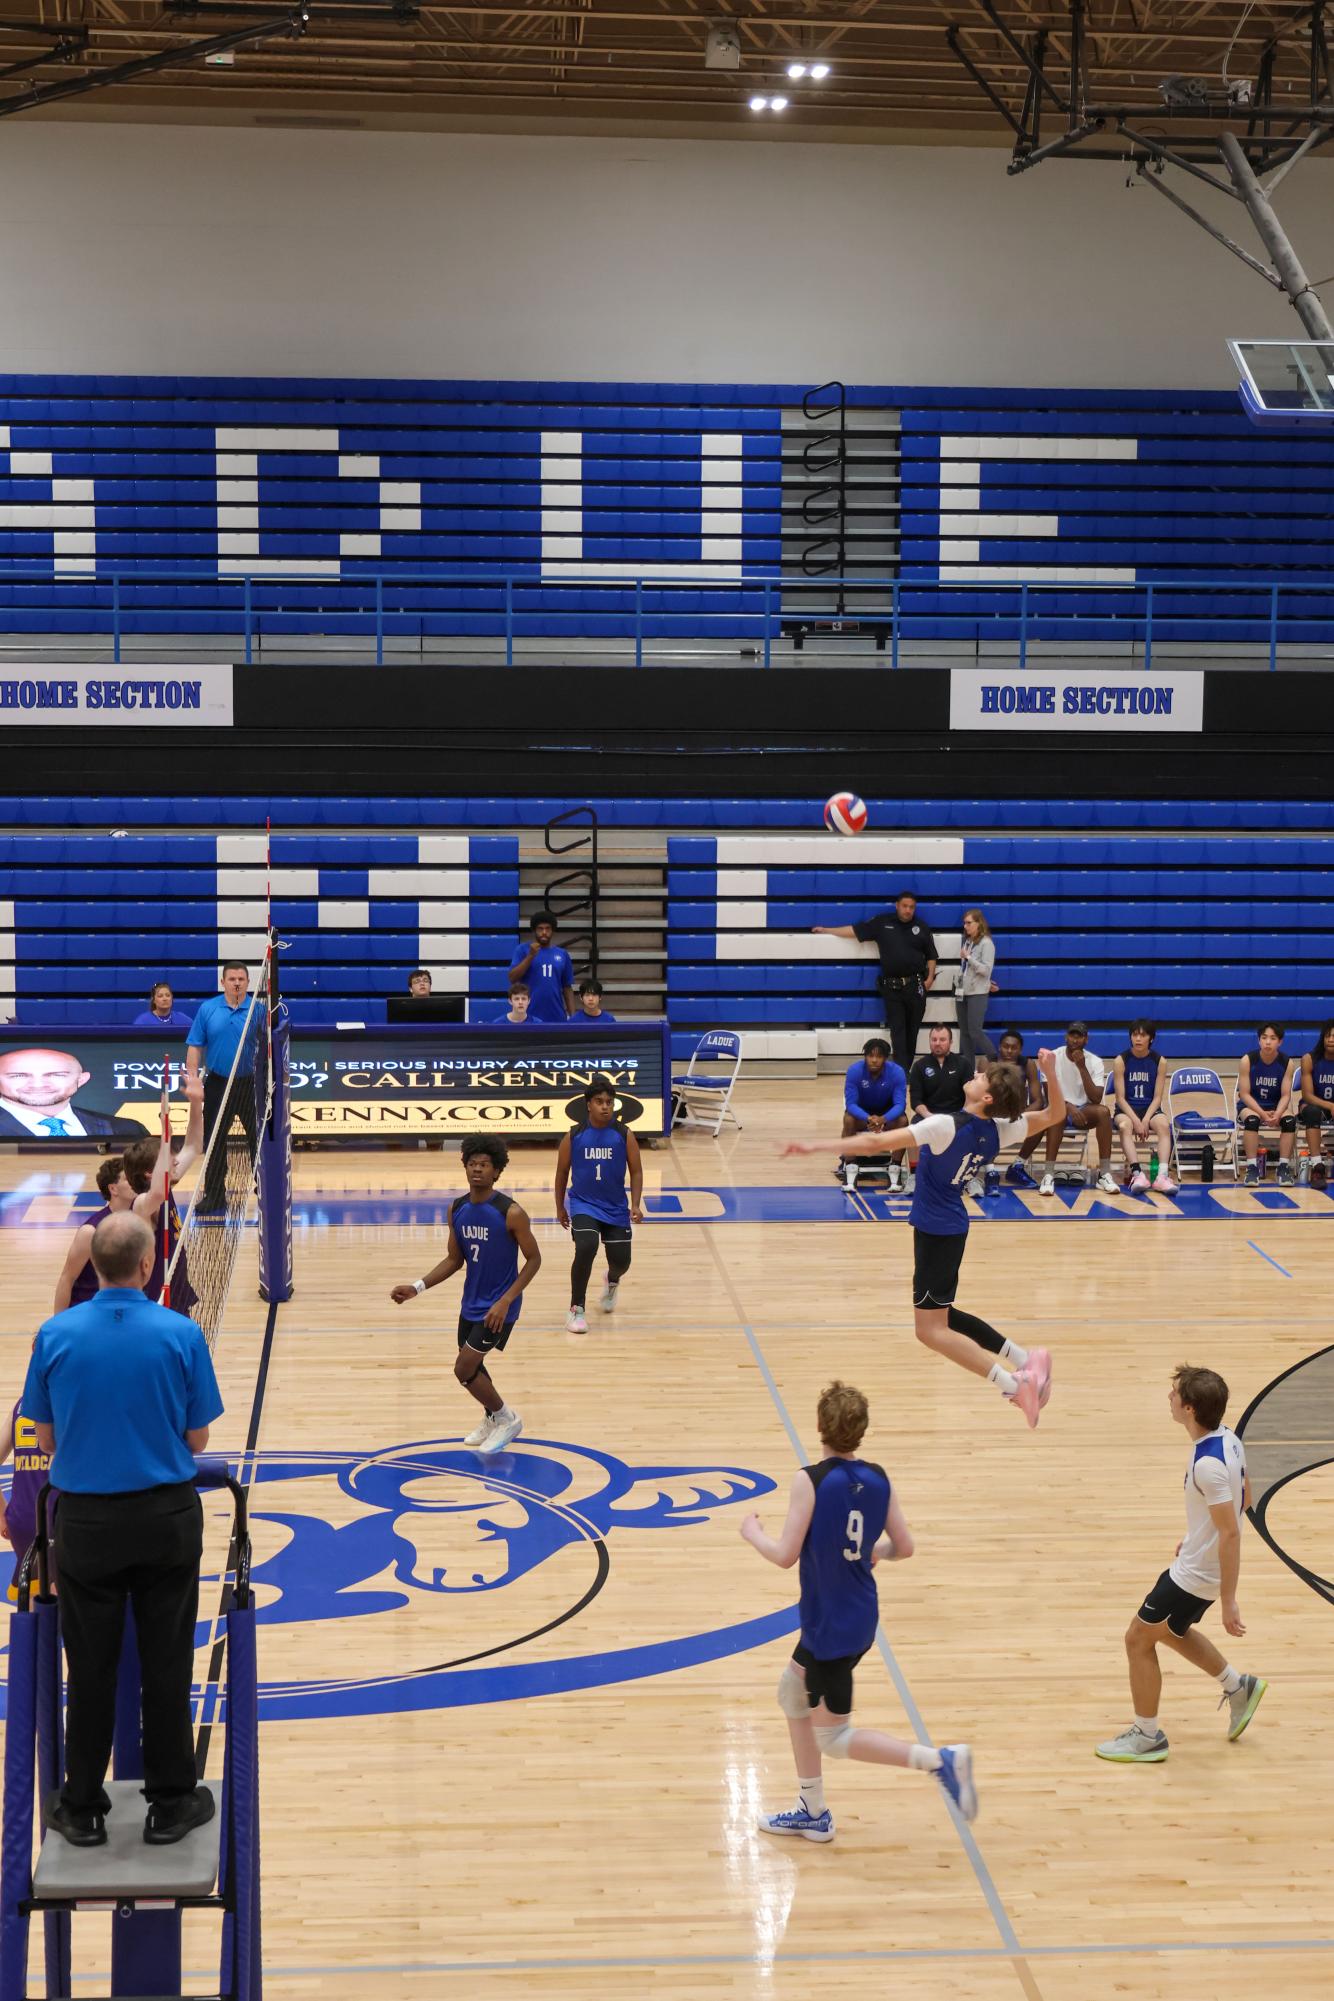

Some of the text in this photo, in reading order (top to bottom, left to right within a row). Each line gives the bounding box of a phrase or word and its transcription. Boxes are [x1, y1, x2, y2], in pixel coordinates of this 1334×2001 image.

[0, 680, 202, 709] HOME SECTION
[980, 686, 1174, 715] HOME SECTION
[542, 964, 552, 977] 11
[706, 1035, 735, 1047] LADUE
[335, 1061, 427, 1070] SERIOUS
[433, 1061, 509, 1069] INJURY
[513, 1060, 639, 1069] ATTORNEYS
[341, 1072, 455, 1088] CALL
[467, 1071, 636, 1087] KENNY!
[1178, 1074, 1212, 1085] LADUE
[1255, 1076, 1278, 1087] LADUE
[1133, 1084, 1144, 1099] 11
[1323, 1086, 1333, 1100] 8
[584, 1147, 613, 1160] LADUE
[595, 1164, 602, 1181] 1
[462, 1225, 489, 1242] LADUE
[843, 1510, 864, 1561] 9
